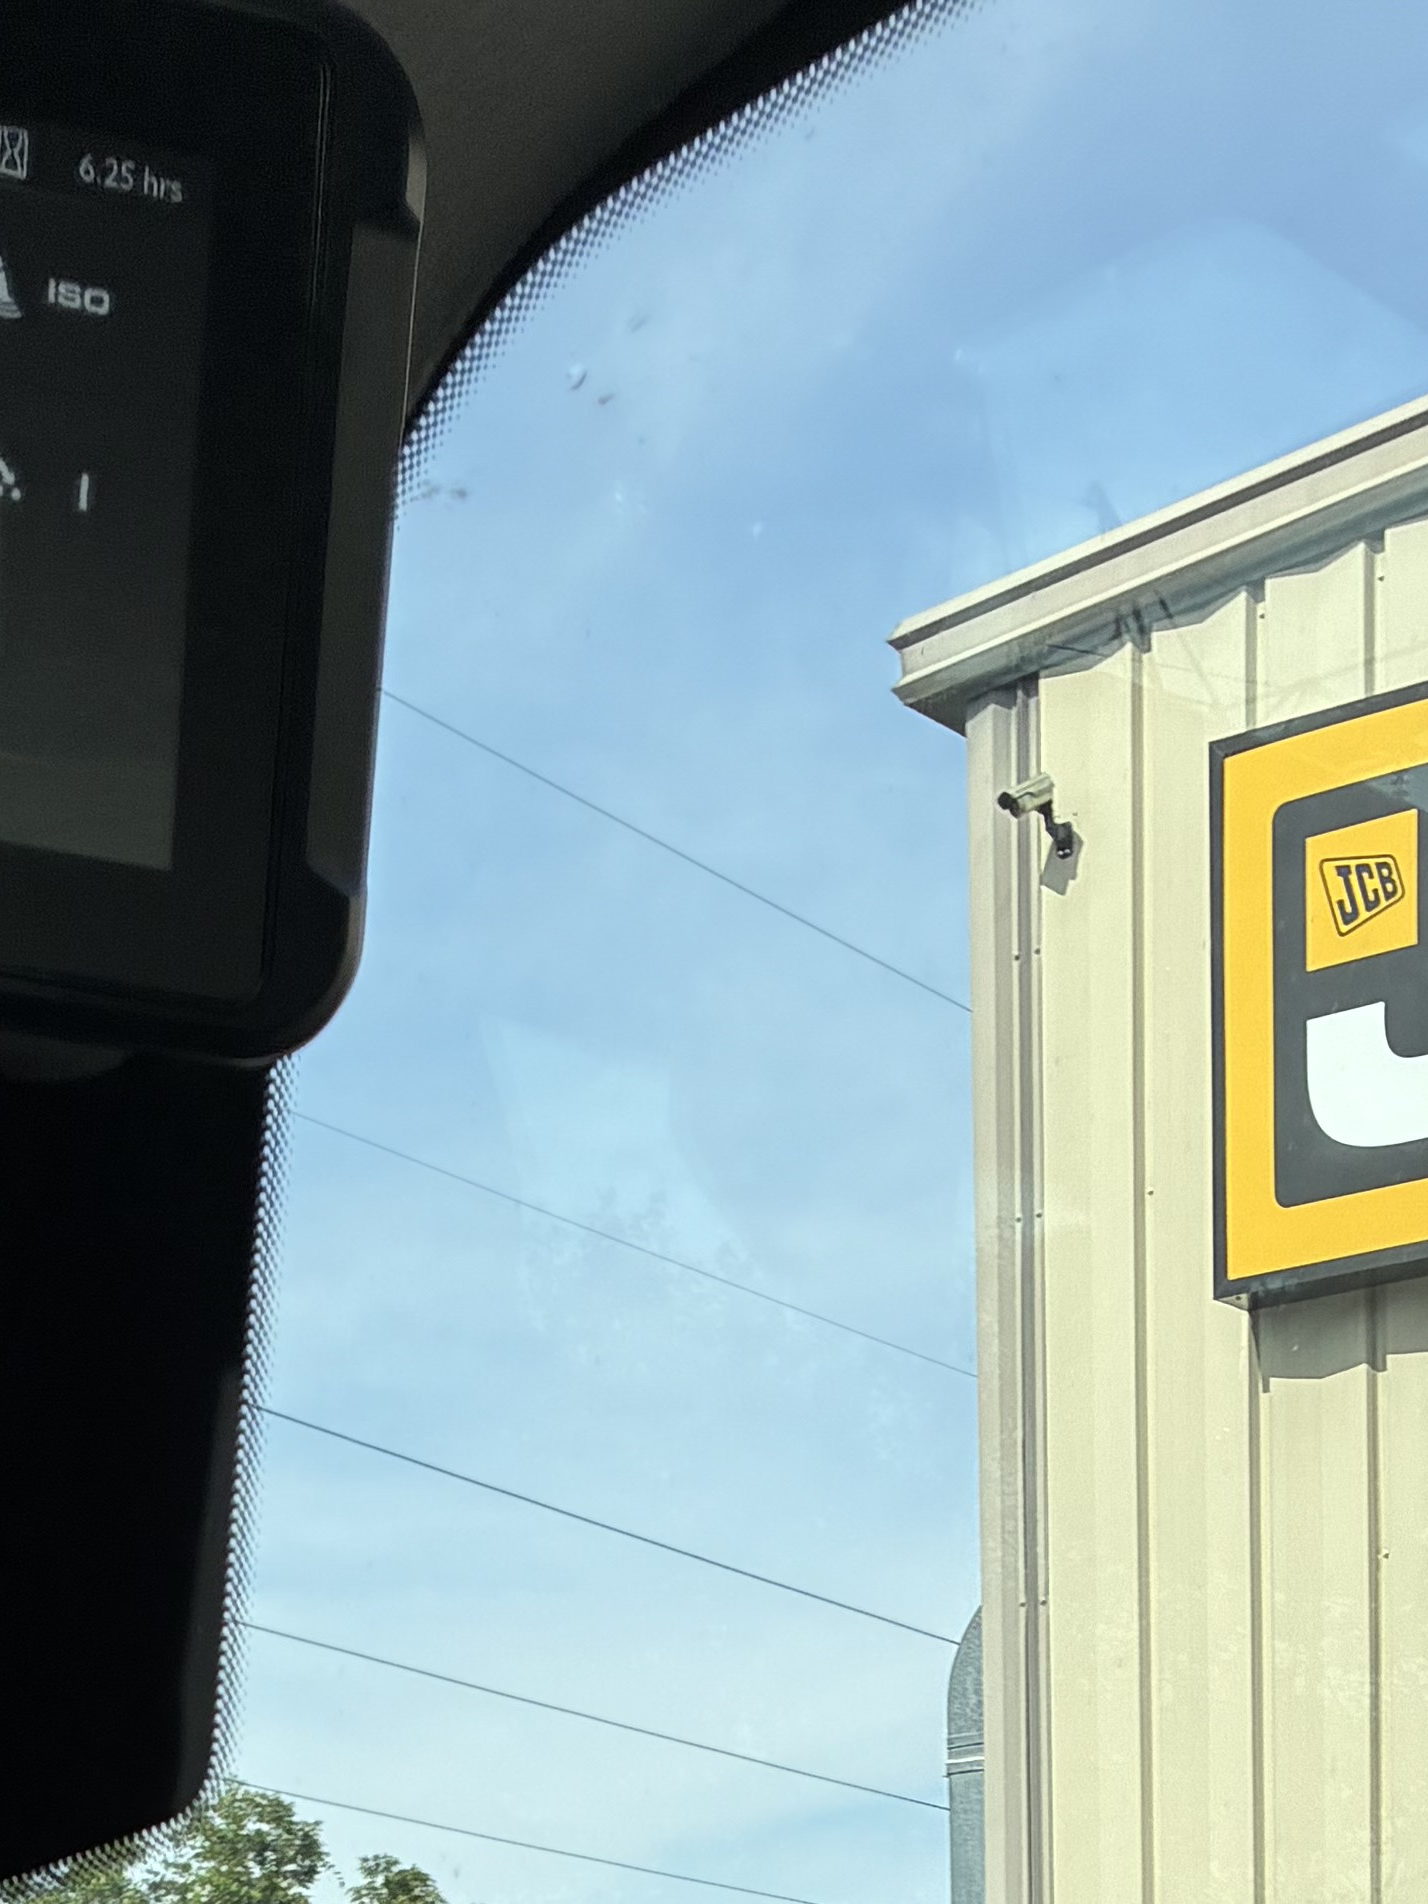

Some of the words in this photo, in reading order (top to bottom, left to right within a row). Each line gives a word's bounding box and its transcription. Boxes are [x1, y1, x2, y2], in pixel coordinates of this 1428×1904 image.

[78, 152, 136, 193] 6.25
[142, 164, 183, 204] hrs
[46, 276, 112, 316] ISO
[1334, 860, 1399, 927] JCB
